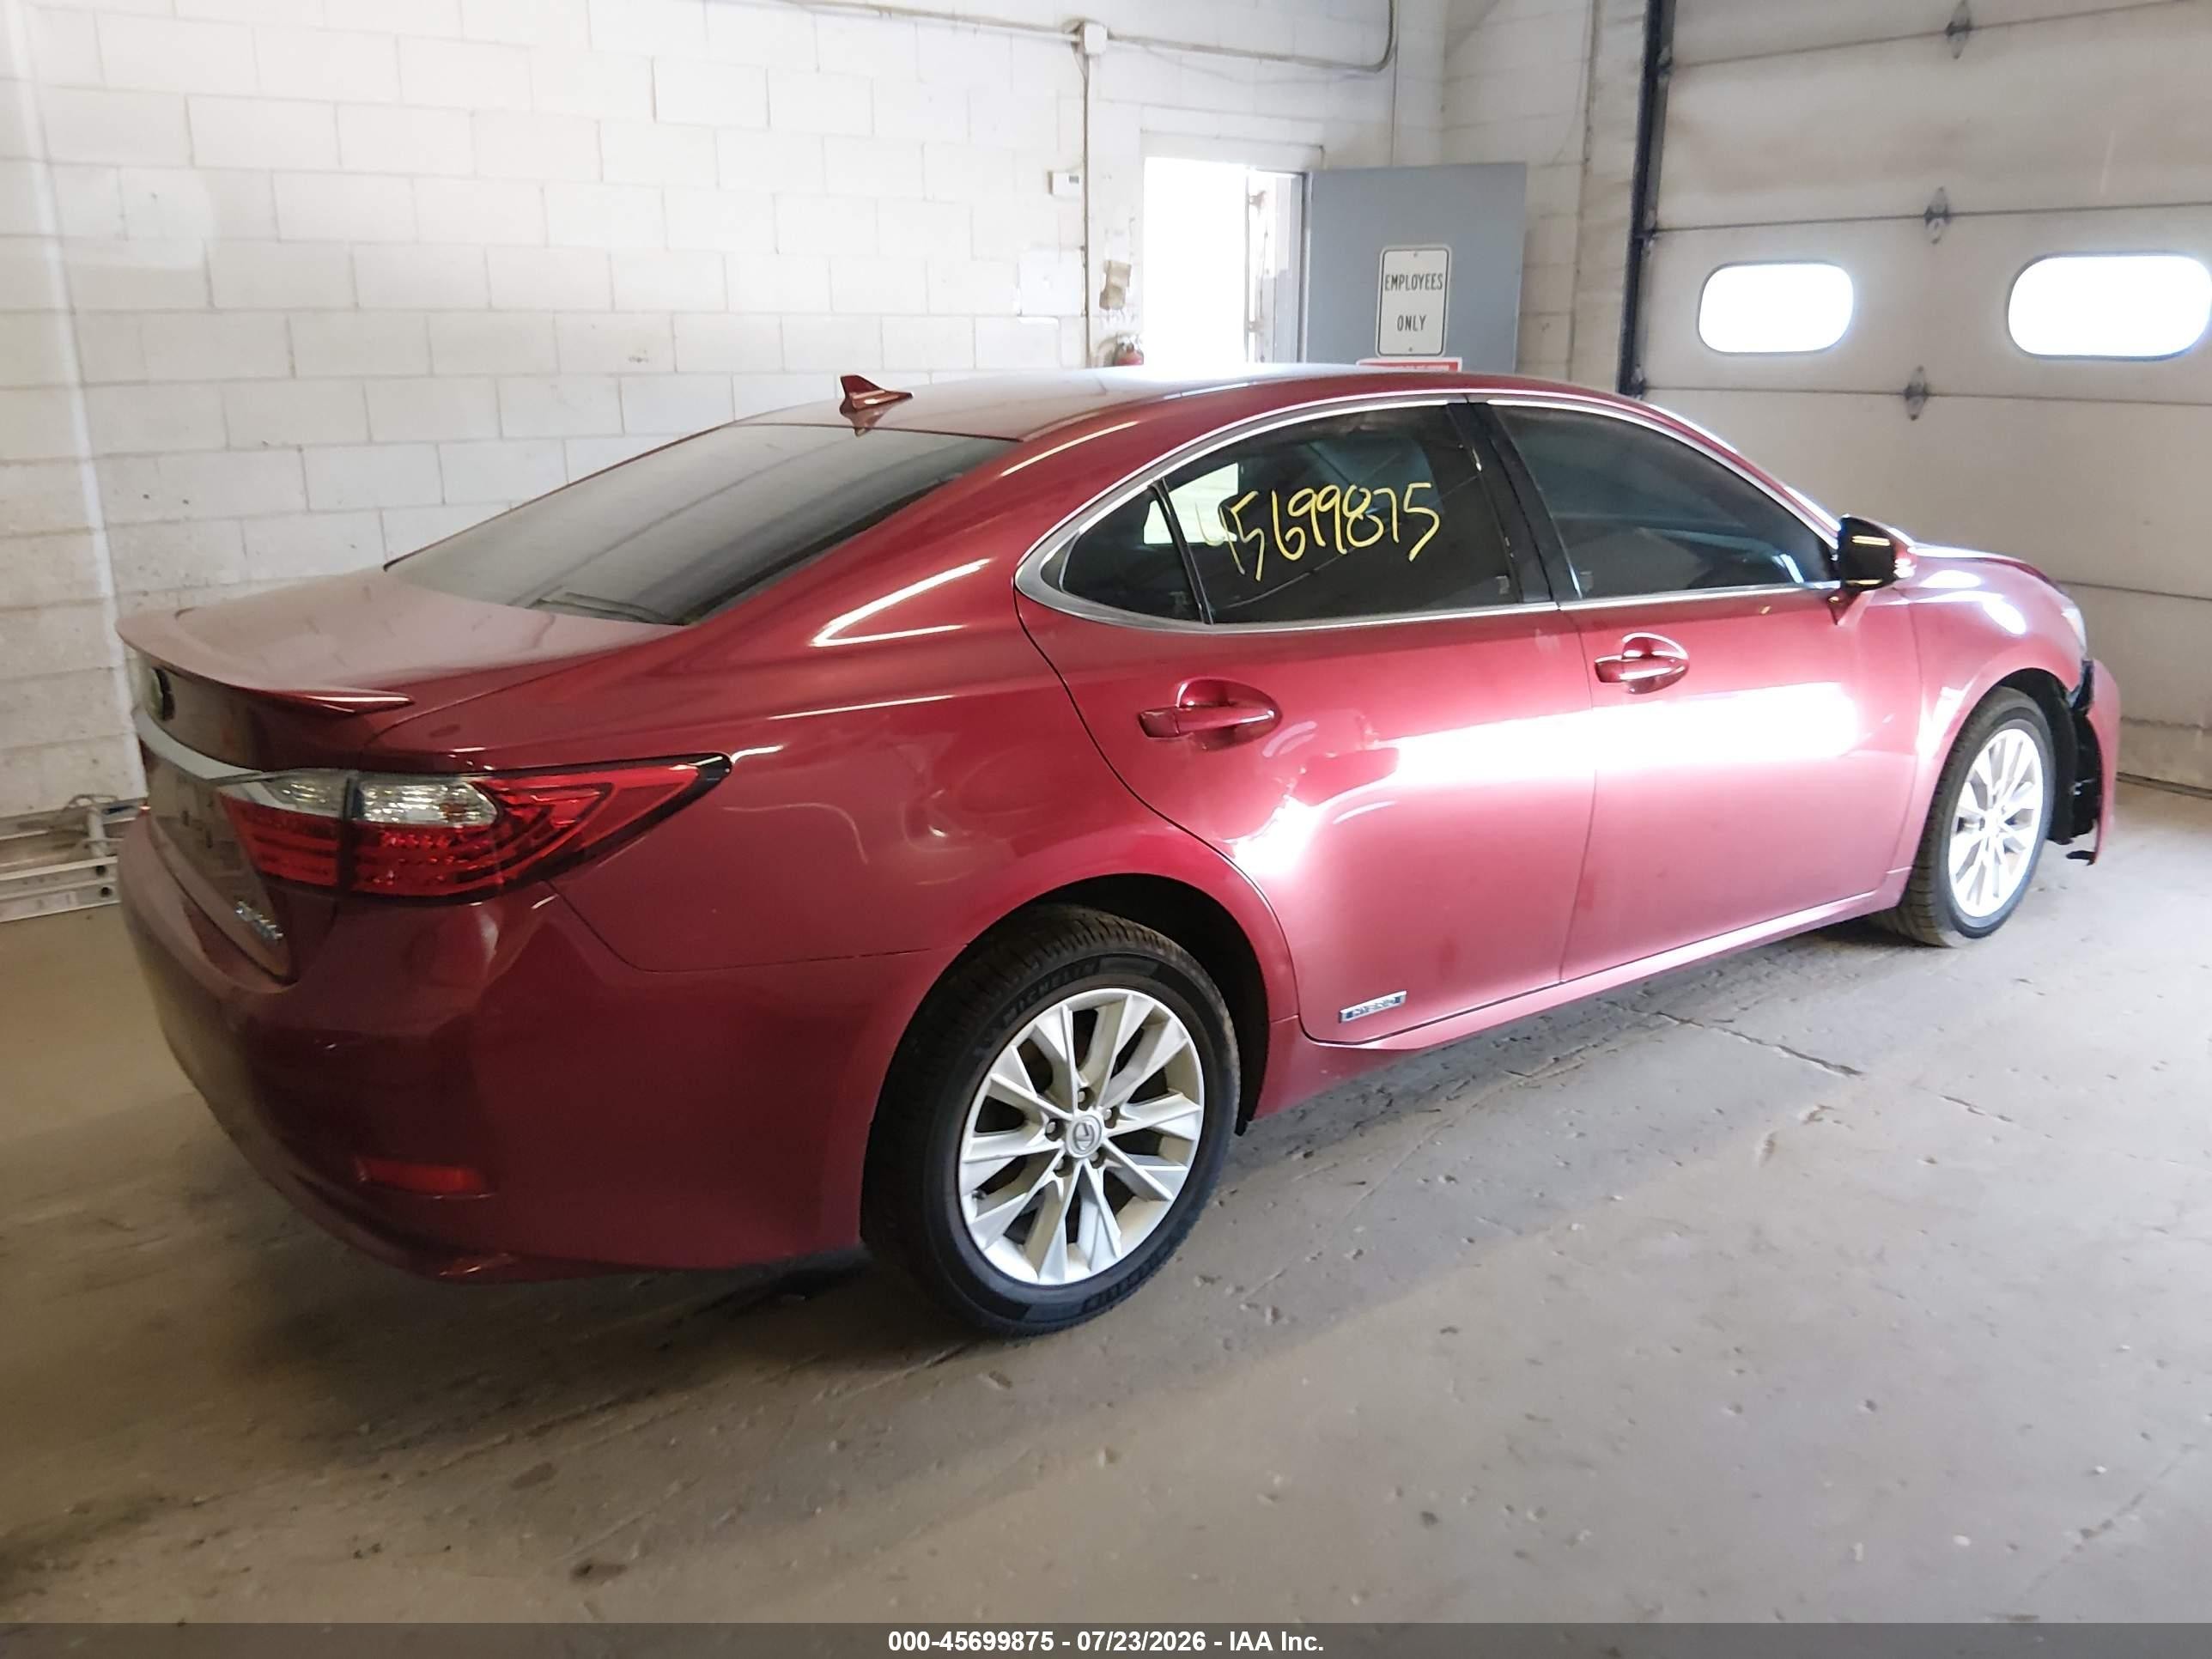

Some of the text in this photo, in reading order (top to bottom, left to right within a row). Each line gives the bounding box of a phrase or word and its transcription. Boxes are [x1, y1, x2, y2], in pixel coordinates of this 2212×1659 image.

[1384, 273, 1443, 291] EMPLOYEES
[1396, 314, 1427, 332] ONLY
[1194, 483, 1441, 581] 45699875
